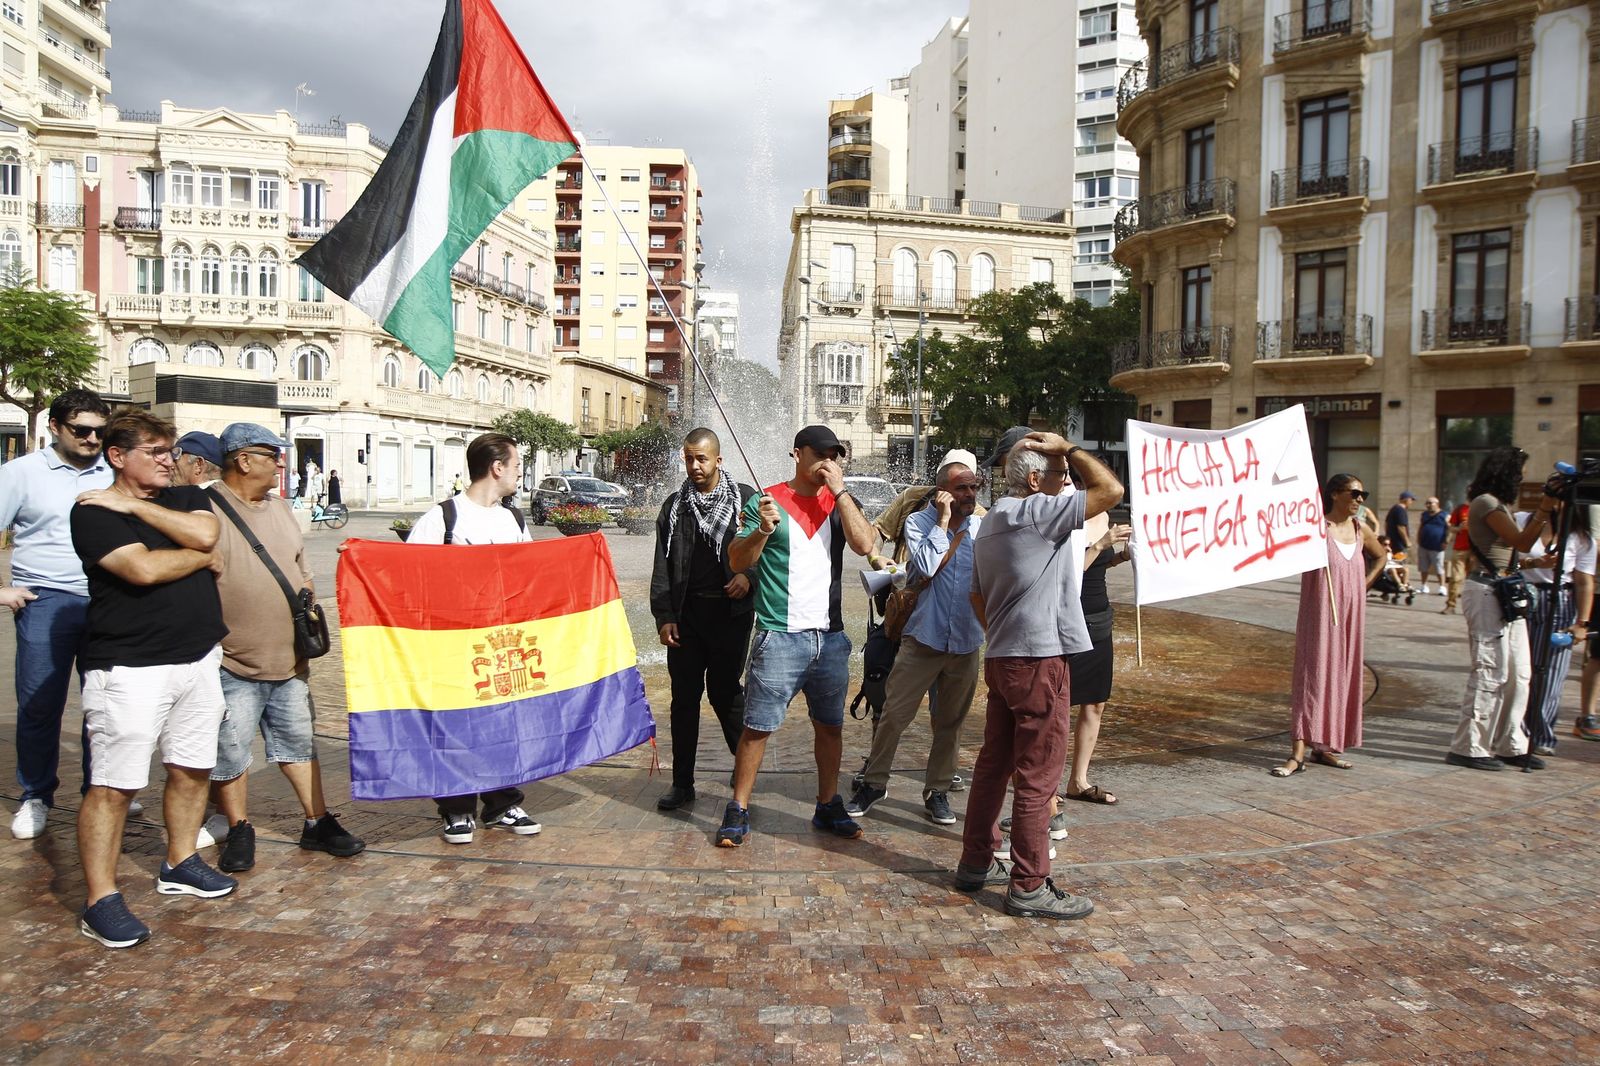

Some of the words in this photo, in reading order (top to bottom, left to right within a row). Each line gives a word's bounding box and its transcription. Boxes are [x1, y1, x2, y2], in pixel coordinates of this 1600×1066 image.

[1303, 397, 1373, 416] ajamar
[1141, 438, 1223, 495] HACIA
[1222, 436, 1260, 484] LA
[1143, 494, 1248, 563] HUELGA
[1257, 487, 1327, 560] general
